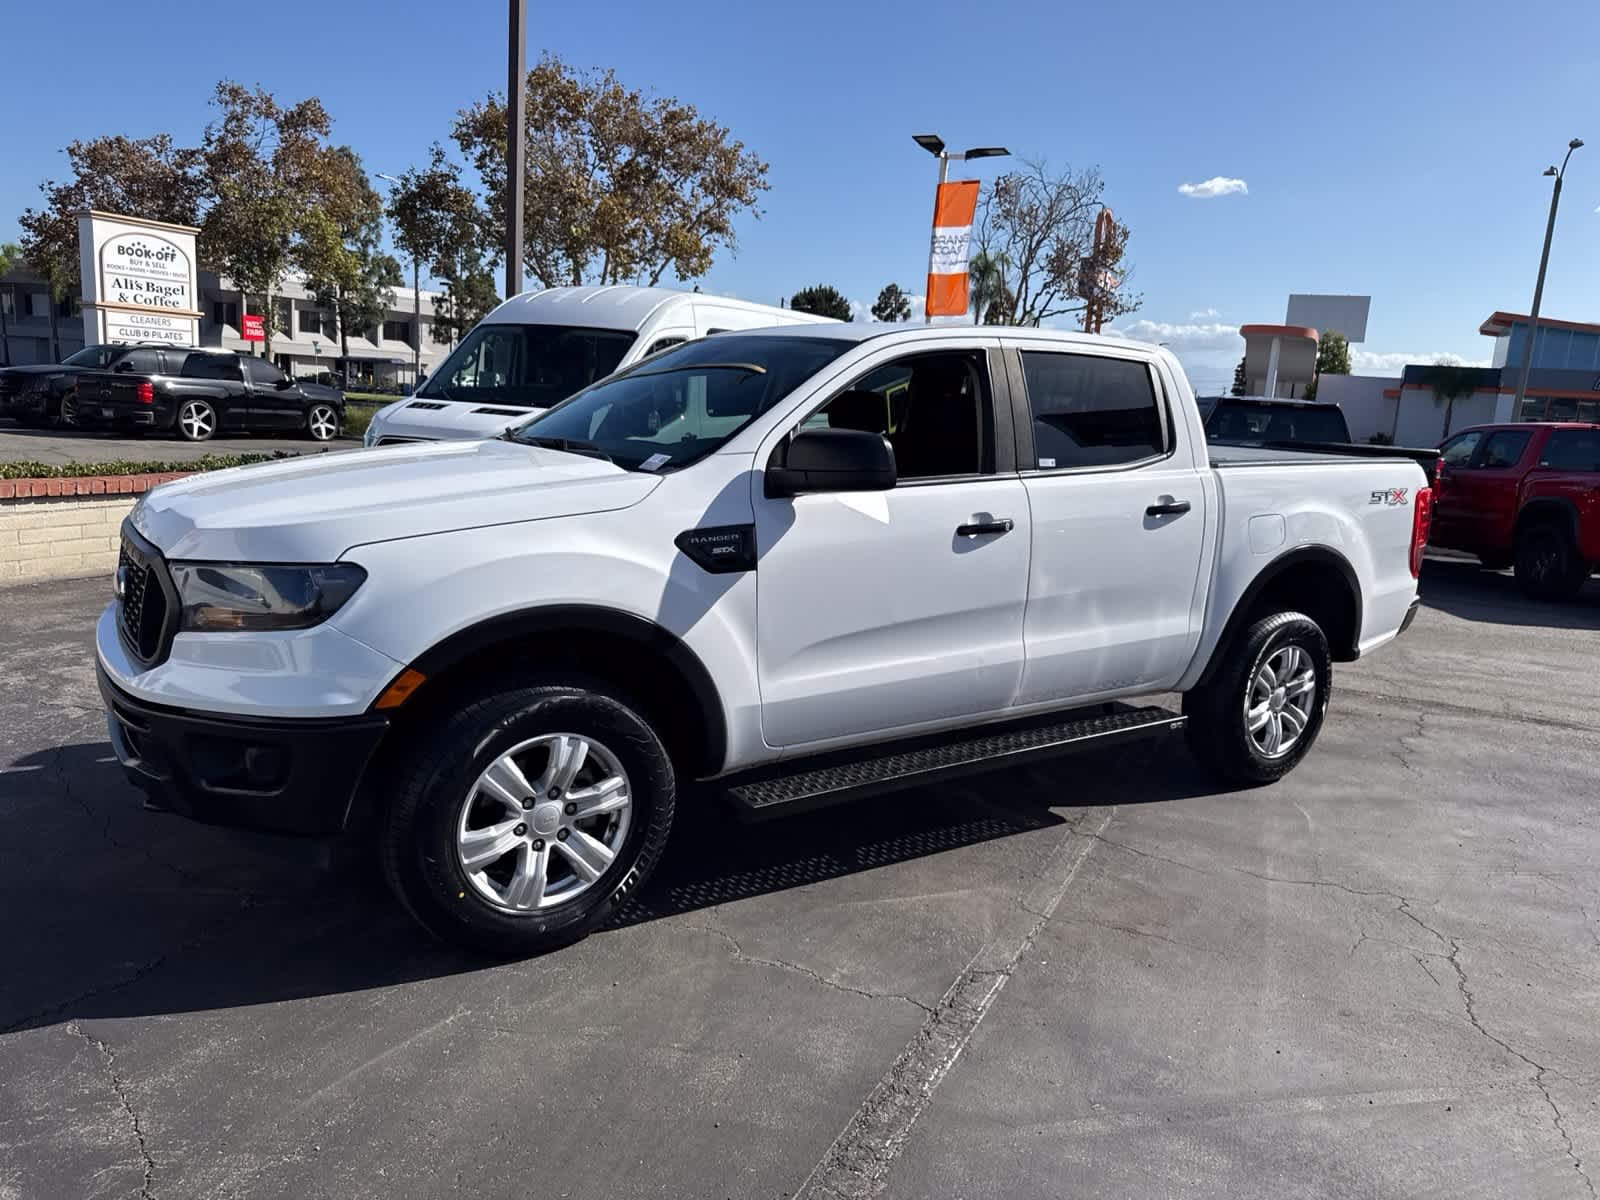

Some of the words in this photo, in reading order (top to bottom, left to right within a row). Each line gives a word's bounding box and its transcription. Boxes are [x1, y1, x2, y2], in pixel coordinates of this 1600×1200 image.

[129, 258, 143, 266] BUY
[112, 277, 143, 291] Ali's
[146, 282, 185, 297] Bagel
[118, 292, 128, 303] &
[133, 294, 180, 308] Coffee
[130, 315, 172, 326] CLEANERS
[119, 328, 141, 337] CLUB
[152, 331, 183, 341] PILATES
[246, 328, 264, 336] FARG
[1369, 488, 1408, 505] STX
[690, 534, 739, 544] RANGER
[712, 546, 736, 554] STX
